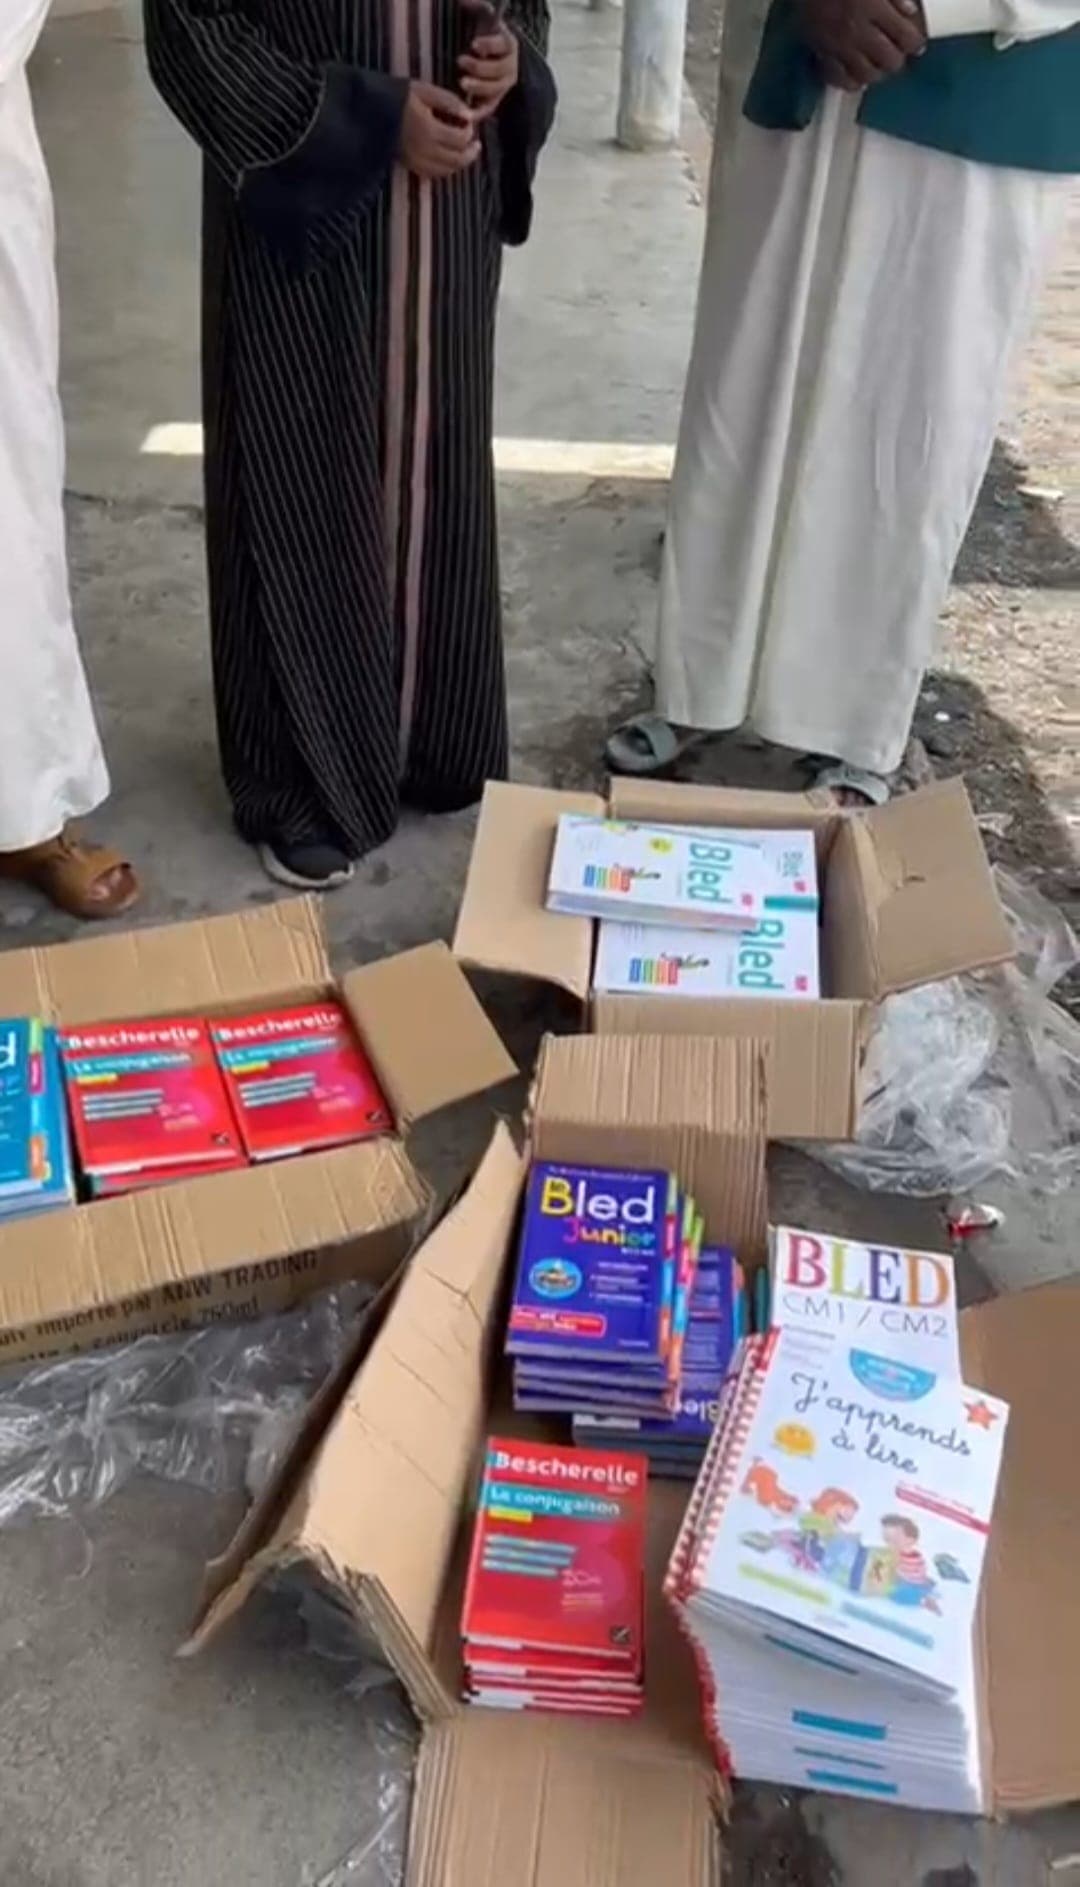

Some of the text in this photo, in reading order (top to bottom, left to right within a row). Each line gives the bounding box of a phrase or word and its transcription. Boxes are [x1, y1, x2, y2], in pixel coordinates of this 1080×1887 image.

[687, 842, 732, 904] Bled
[68, 1026, 200, 1049] Bescherelle
[219, 1011, 341, 1041] Bescherelle
[540, 1175, 656, 1223] Bled
[564, 1216, 656, 1246] Junior
[784, 1233, 950, 1309] BLED
[783, 1294, 845, 1324] CM1
[880, 1311, 948, 1338] CM2
[791, 1372, 971, 1456] J'apprends
[496, 1452, 639, 1486] Bescherelle
[832, 1428, 919, 1474] à lire
[515, 1492, 620, 1516] conjugaison
